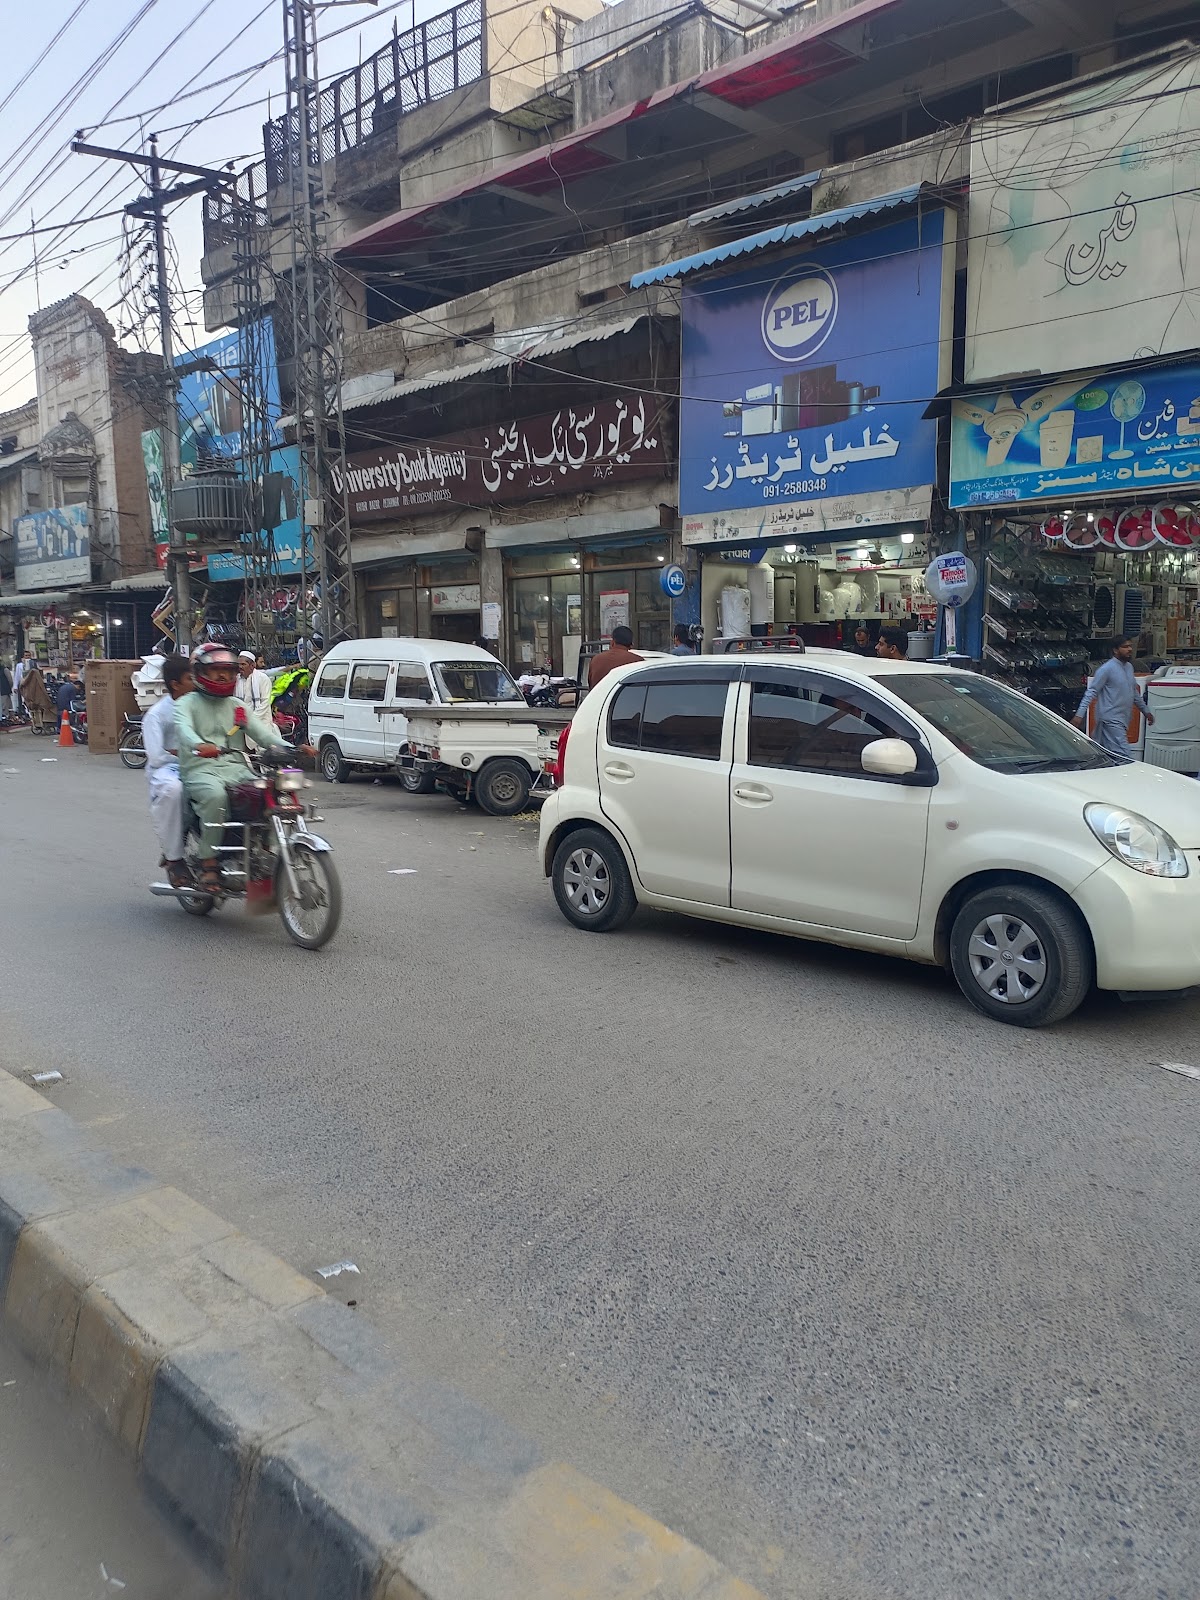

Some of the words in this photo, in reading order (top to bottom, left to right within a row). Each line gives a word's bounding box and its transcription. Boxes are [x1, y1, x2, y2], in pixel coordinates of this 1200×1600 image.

[1064, 191, 1137, 286] فین
[773, 298, 827, 331] PEL
[1138, 399, 1175, 440] فین
[397, 450, 430, 484] Book
[426, 447, 467, 487] Agency
[703, 435, 802, 490] ٹریڈرز
[809, 423, 900, 475] خلیل
[763, 478, 827, 498] 091-2580348
[795, 506, 815, 520] خلیل
[670, 575, 684, 585] PEL
